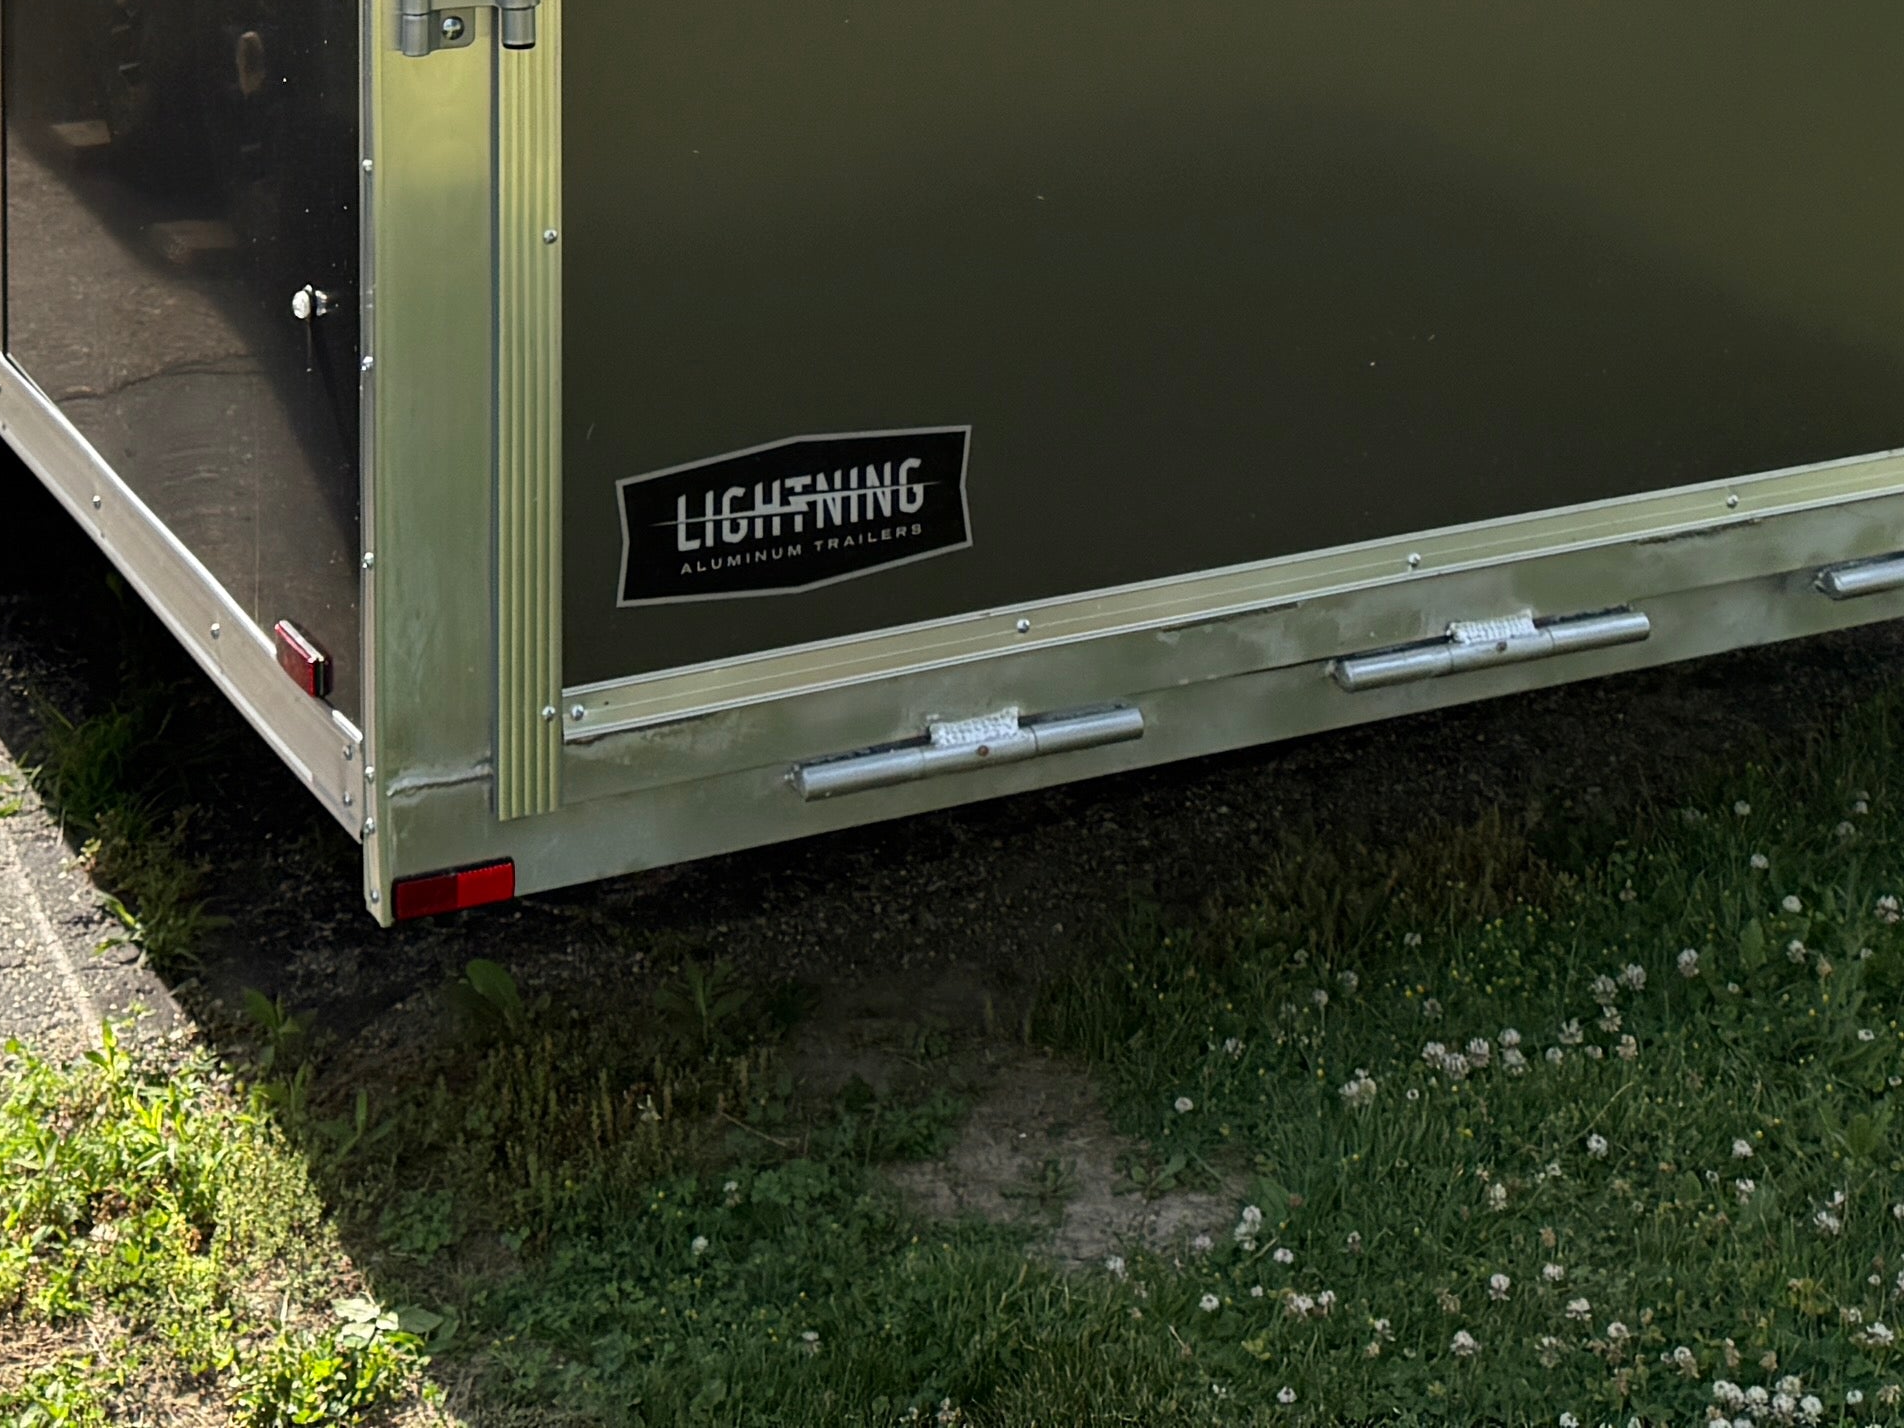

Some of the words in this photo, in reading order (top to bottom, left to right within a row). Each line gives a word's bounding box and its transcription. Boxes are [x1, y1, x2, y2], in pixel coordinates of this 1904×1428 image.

[676, 457, 926, 552] LIGHTNING
[680, 543, 803, 575] ALUMINUM
[814, 523, 924, 552] TRAILERS
